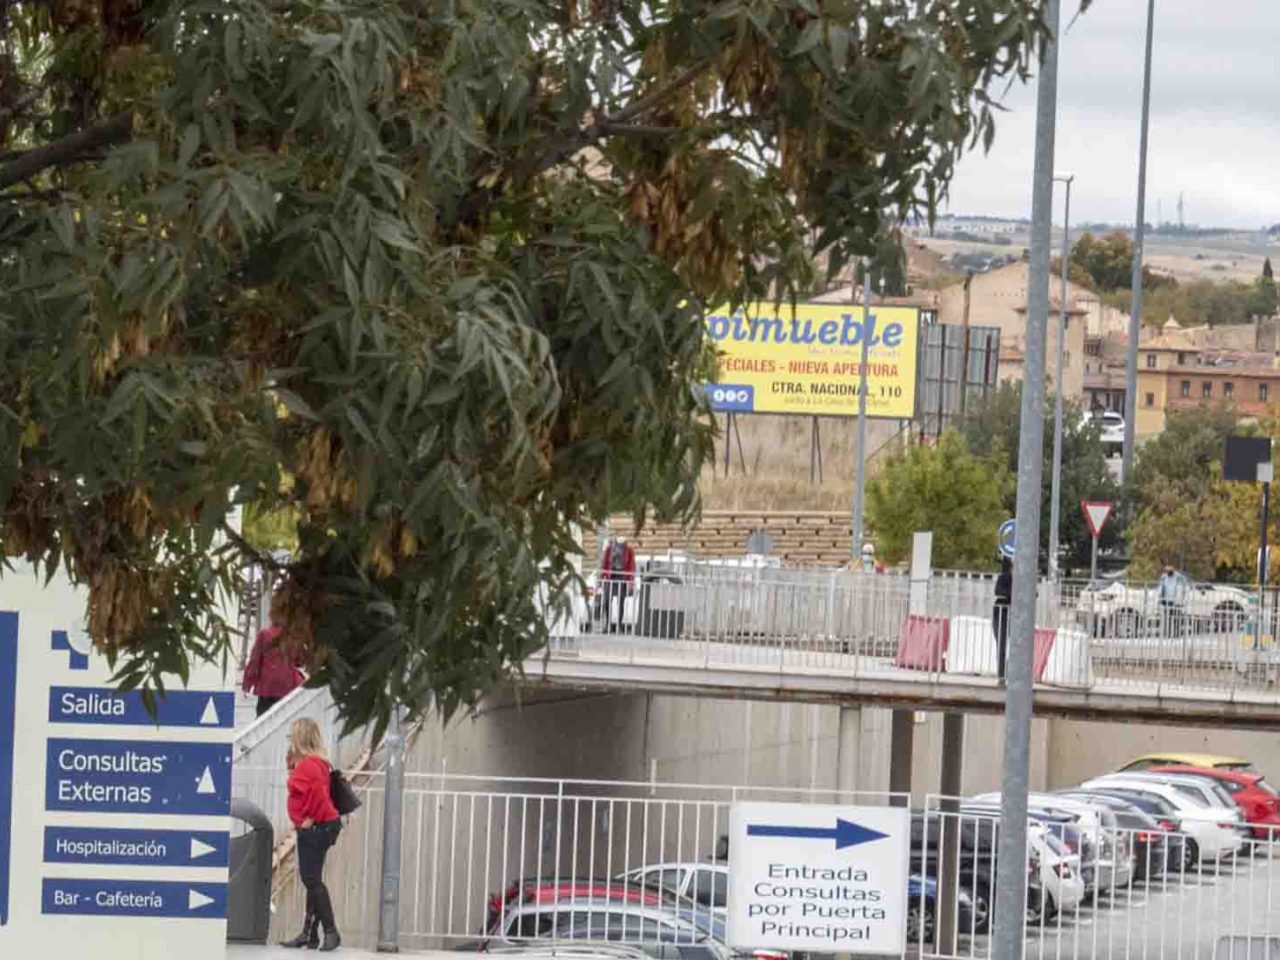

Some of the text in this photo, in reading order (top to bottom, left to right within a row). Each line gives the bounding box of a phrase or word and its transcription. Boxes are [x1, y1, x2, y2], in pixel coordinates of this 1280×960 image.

[789, 361, 829, 375] NUEVA
[880, 386, 902, 398] 110
[61, 692, 125, 716] Salida
[58, 750, 164, 773] Consultas
[57, 780, 152, 803] Externas
[56, 838, 167, 858] Hospitalización
[768, 863, 868, 882] Entrada
[54, 889, 81, 906] Bar
[95, 890, 163, 908] Cafetería
[754, 882, 881, 901] Consultas
[748, 903, 887, 920] por Puerta
[760, 921, 872, 942] Principal
